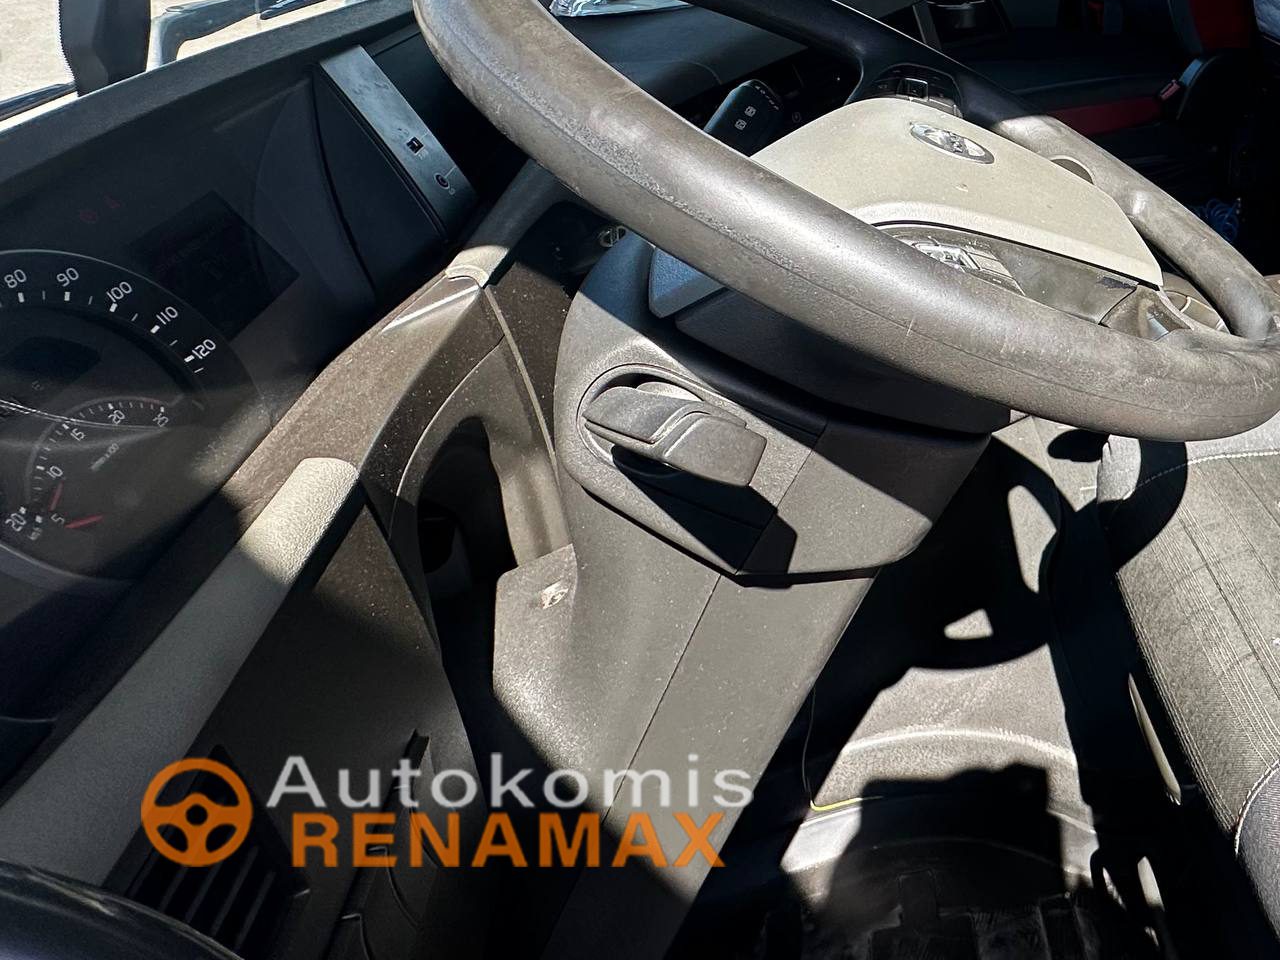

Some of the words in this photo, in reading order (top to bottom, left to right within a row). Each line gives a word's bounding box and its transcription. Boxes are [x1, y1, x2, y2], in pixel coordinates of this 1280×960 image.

[4, 269, 27, 288] 80
[56, 267, 79, 287] 90
[106, 281, 133, 302] 100
[155, 306, 179, 326] 110
[191, 338, 217, 359] 120
[108, 409, 125, 425] 20
[70, 428, 86, 441] 15
[47, 466, 63, 479] 10
[5, 513, 27, 532] 20
[51, 513, 65, 525] 5
